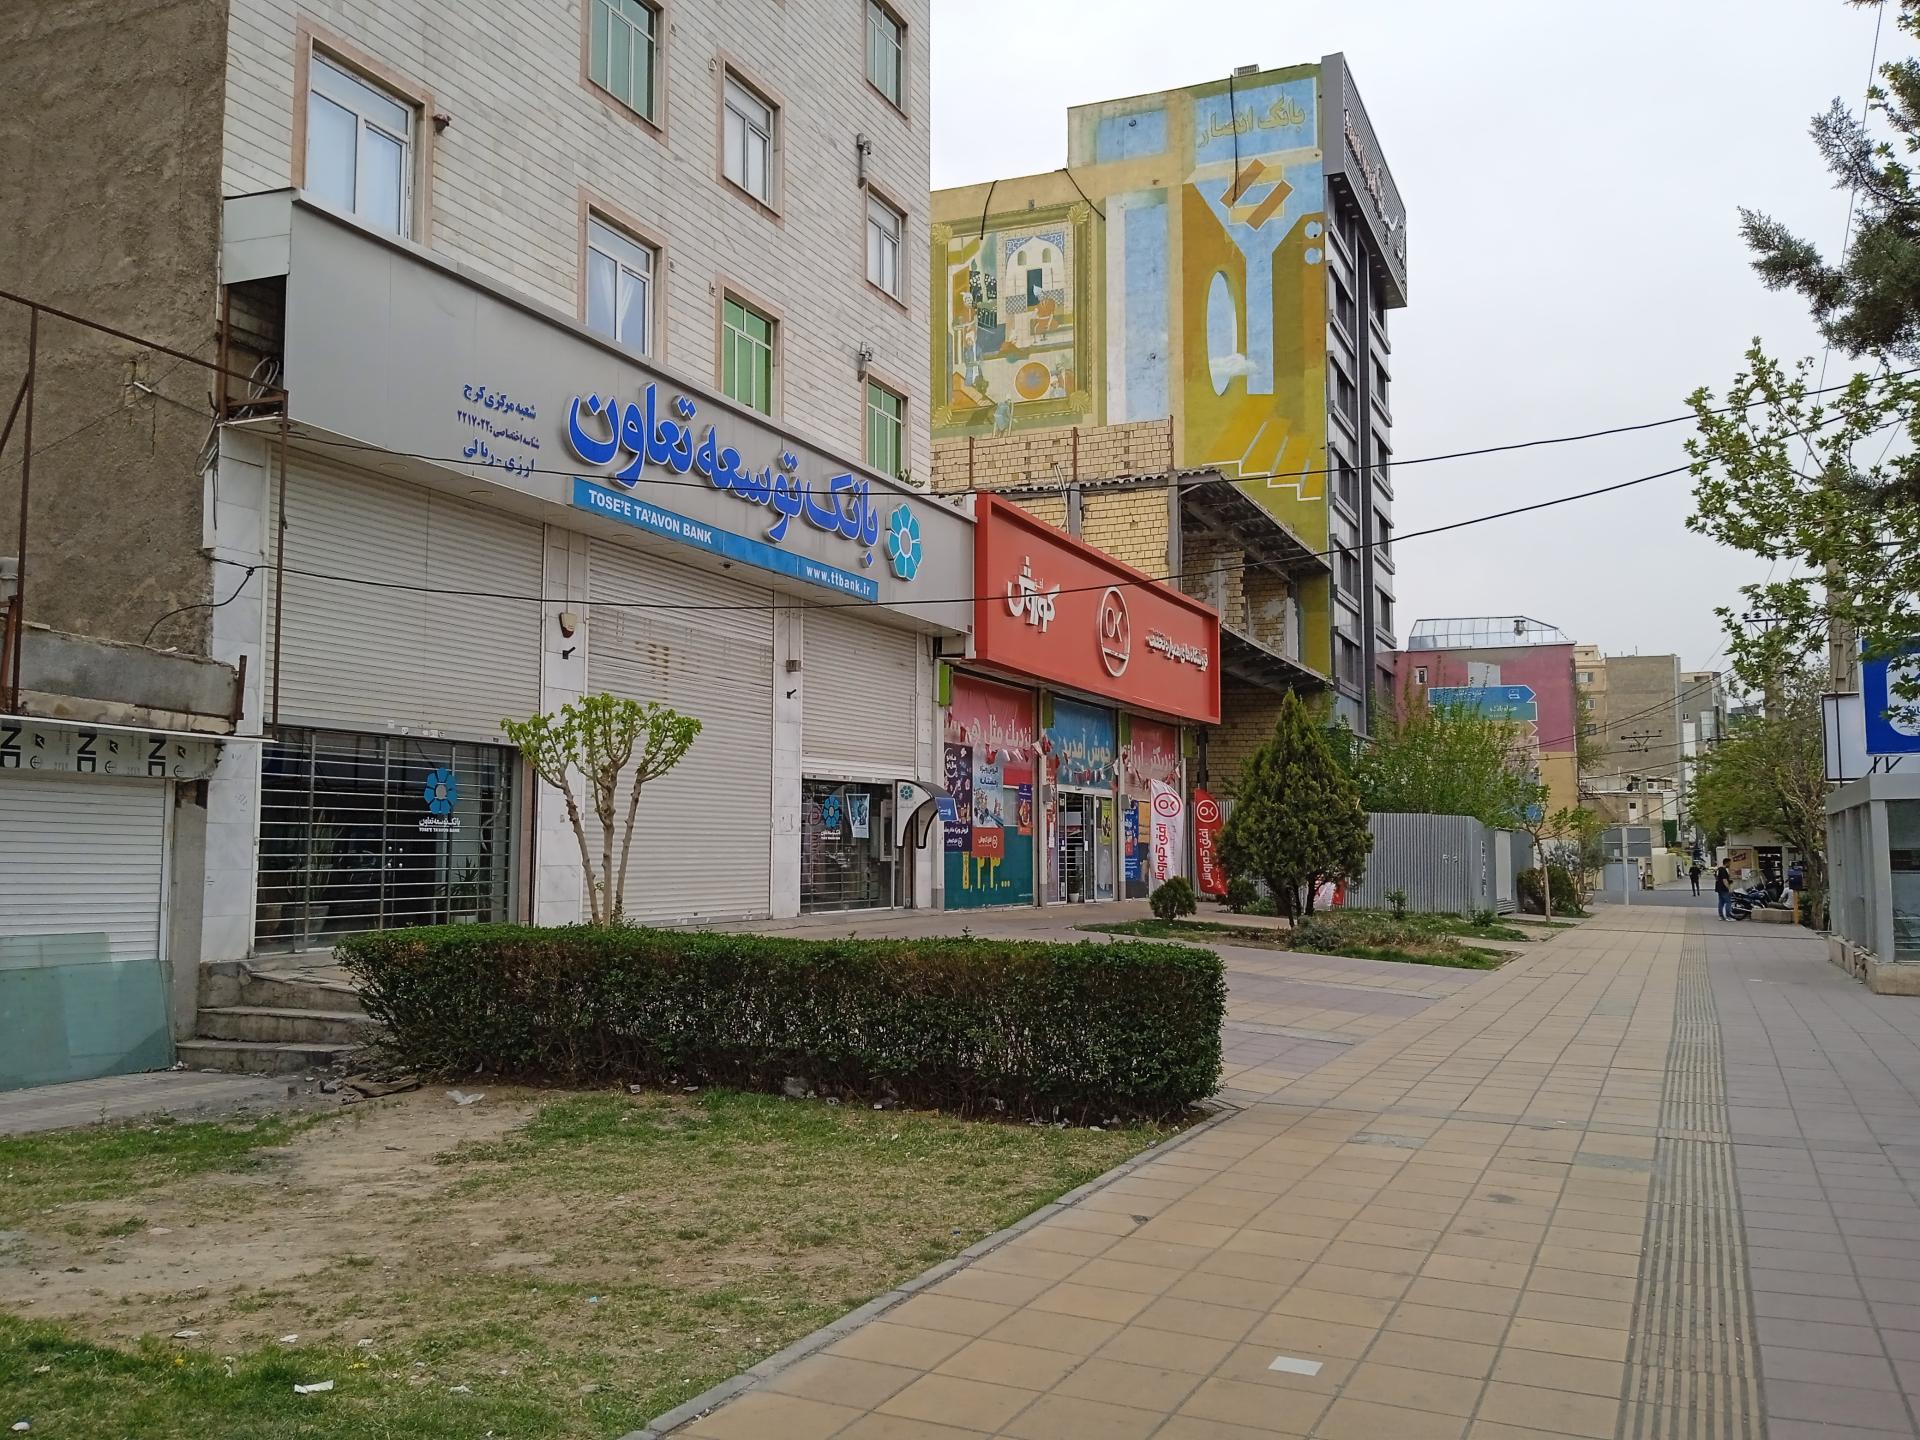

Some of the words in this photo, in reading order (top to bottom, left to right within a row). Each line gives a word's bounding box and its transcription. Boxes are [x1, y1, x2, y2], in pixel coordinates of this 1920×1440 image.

[463, 384, 486, 403] کرج
[484, 391, 515, 414] مرکزی
[515, 404, 536, 421] شعبه
[569, 382, 697, 490] تعاون
[696, 425, 803, 542] توسعه
[683, 522, 712, 545] BANK
[806, 473, 879, 567] بانک
[806, 564, 872, 596] www.ttbank.ir
